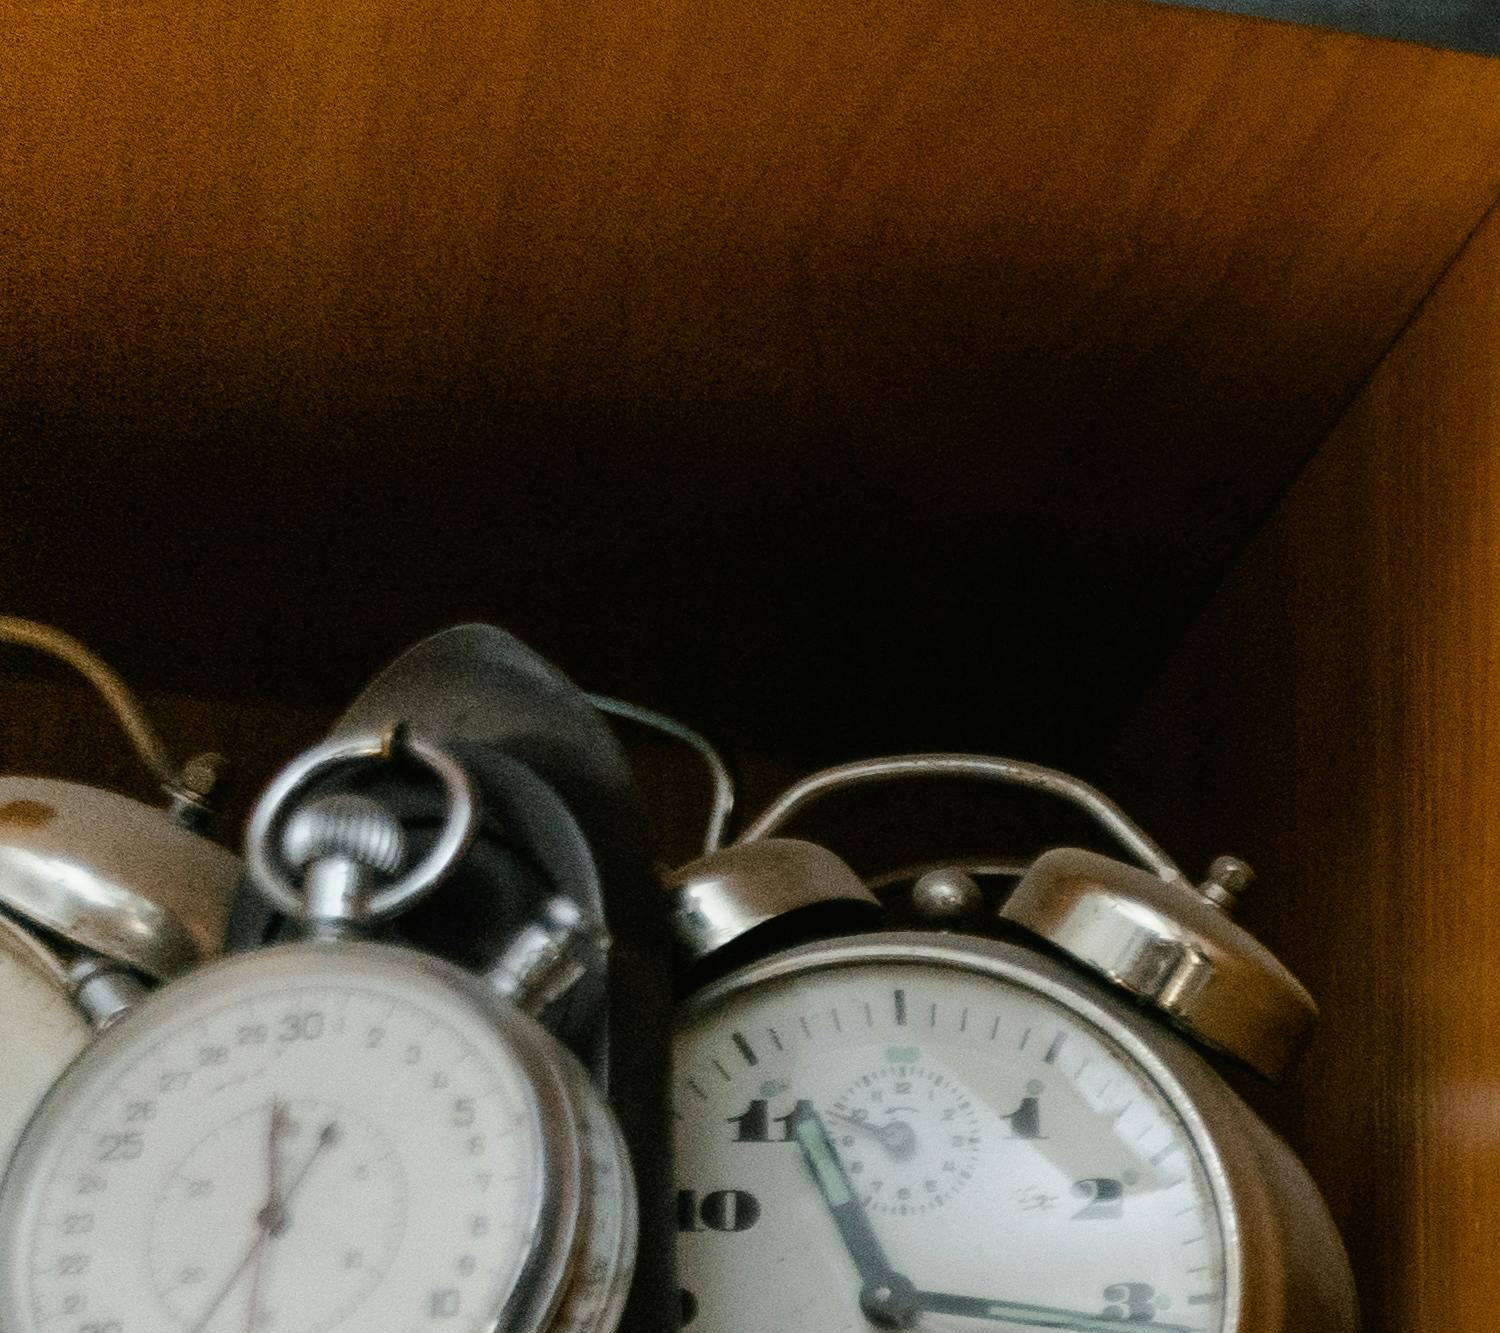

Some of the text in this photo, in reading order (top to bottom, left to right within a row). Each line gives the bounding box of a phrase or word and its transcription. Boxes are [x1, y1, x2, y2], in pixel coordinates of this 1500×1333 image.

[277, 1011, 325, 1043] 30
[1001, 1096, 1049, 1141] 1
[101, 1132, 145, 1163] 25
[1070, 1177, 1124, 1221] 2
[1102, 1281, 1159, 1322] 3
